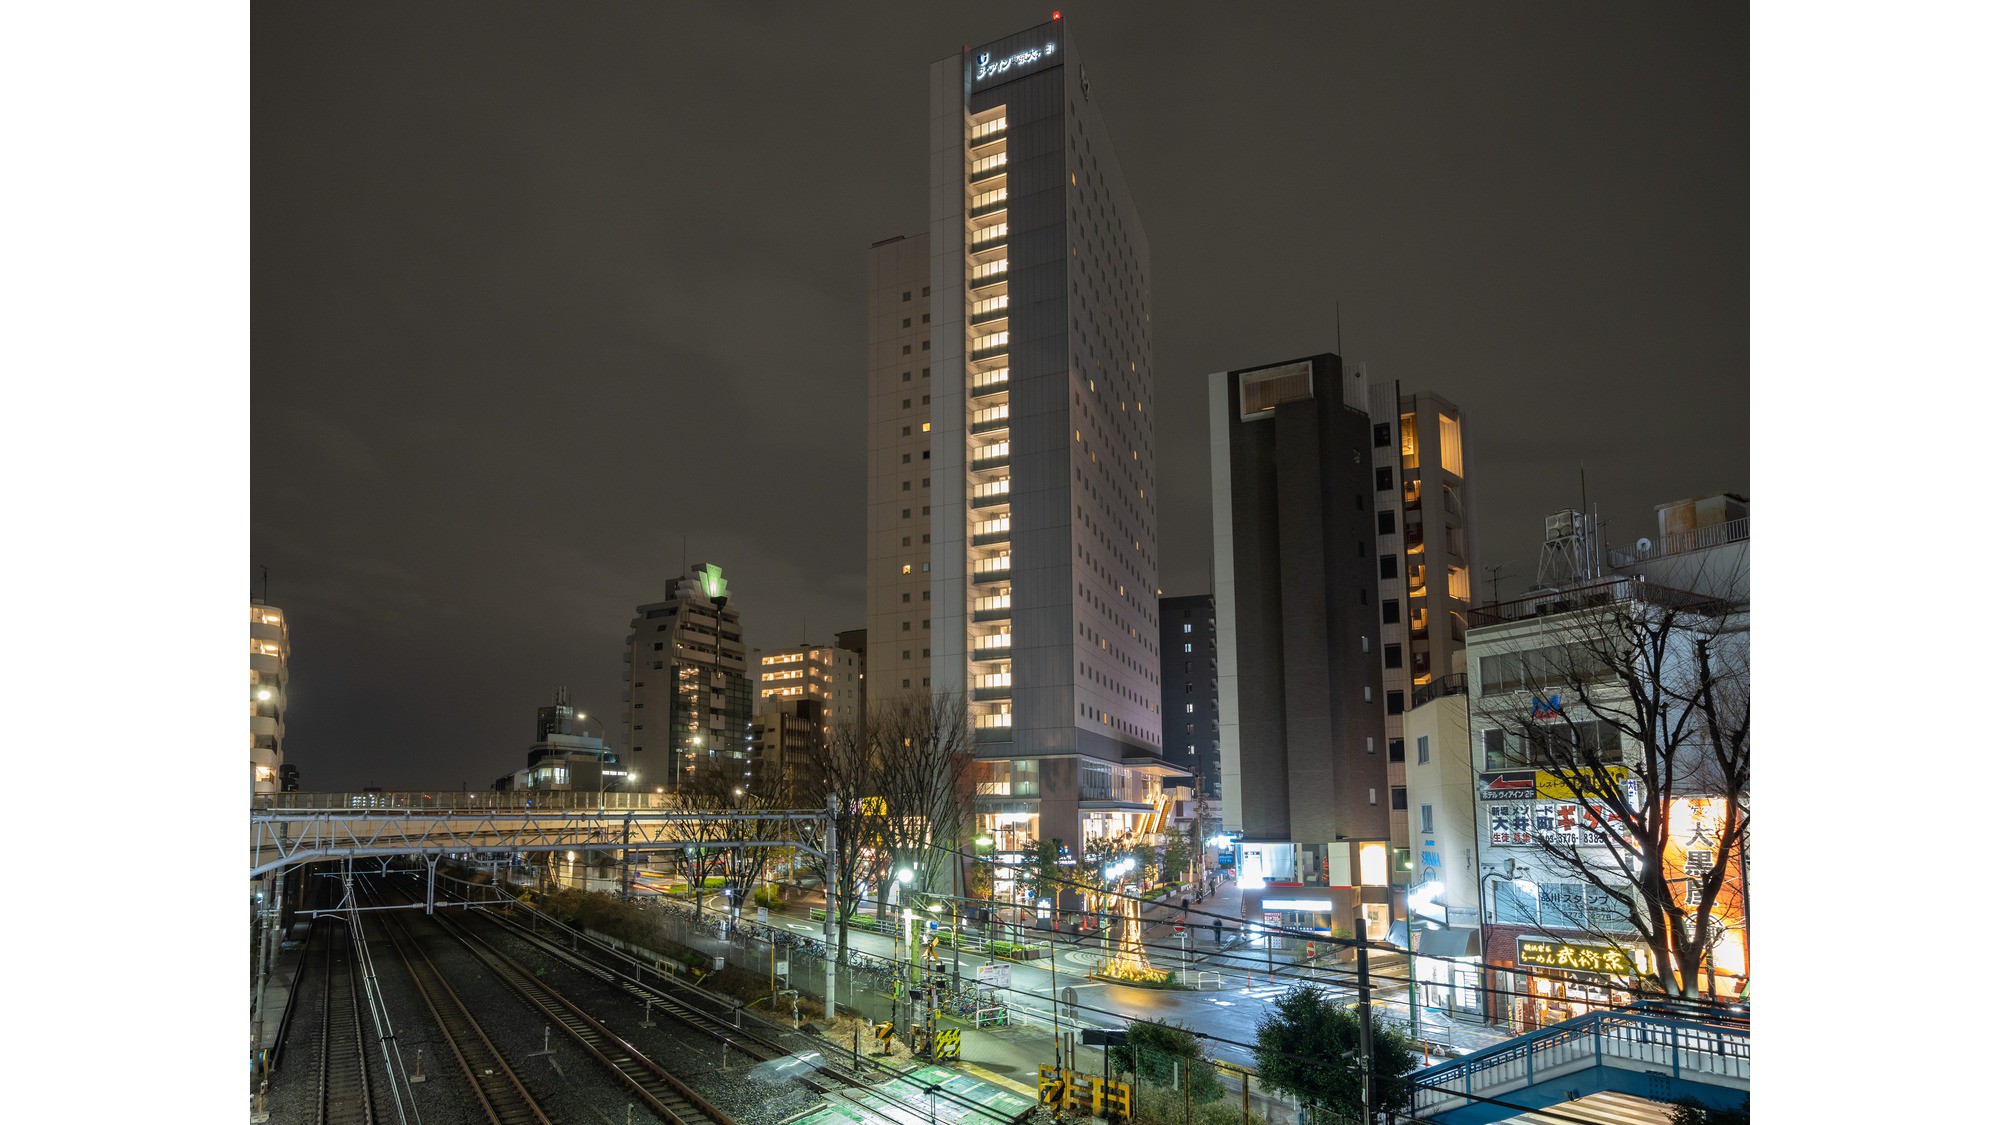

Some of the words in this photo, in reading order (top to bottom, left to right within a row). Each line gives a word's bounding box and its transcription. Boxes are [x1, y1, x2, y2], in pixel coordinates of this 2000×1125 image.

[1521, 951, 1556, 965] らーめん
[1557, 946, 1624, 971] 武術家
